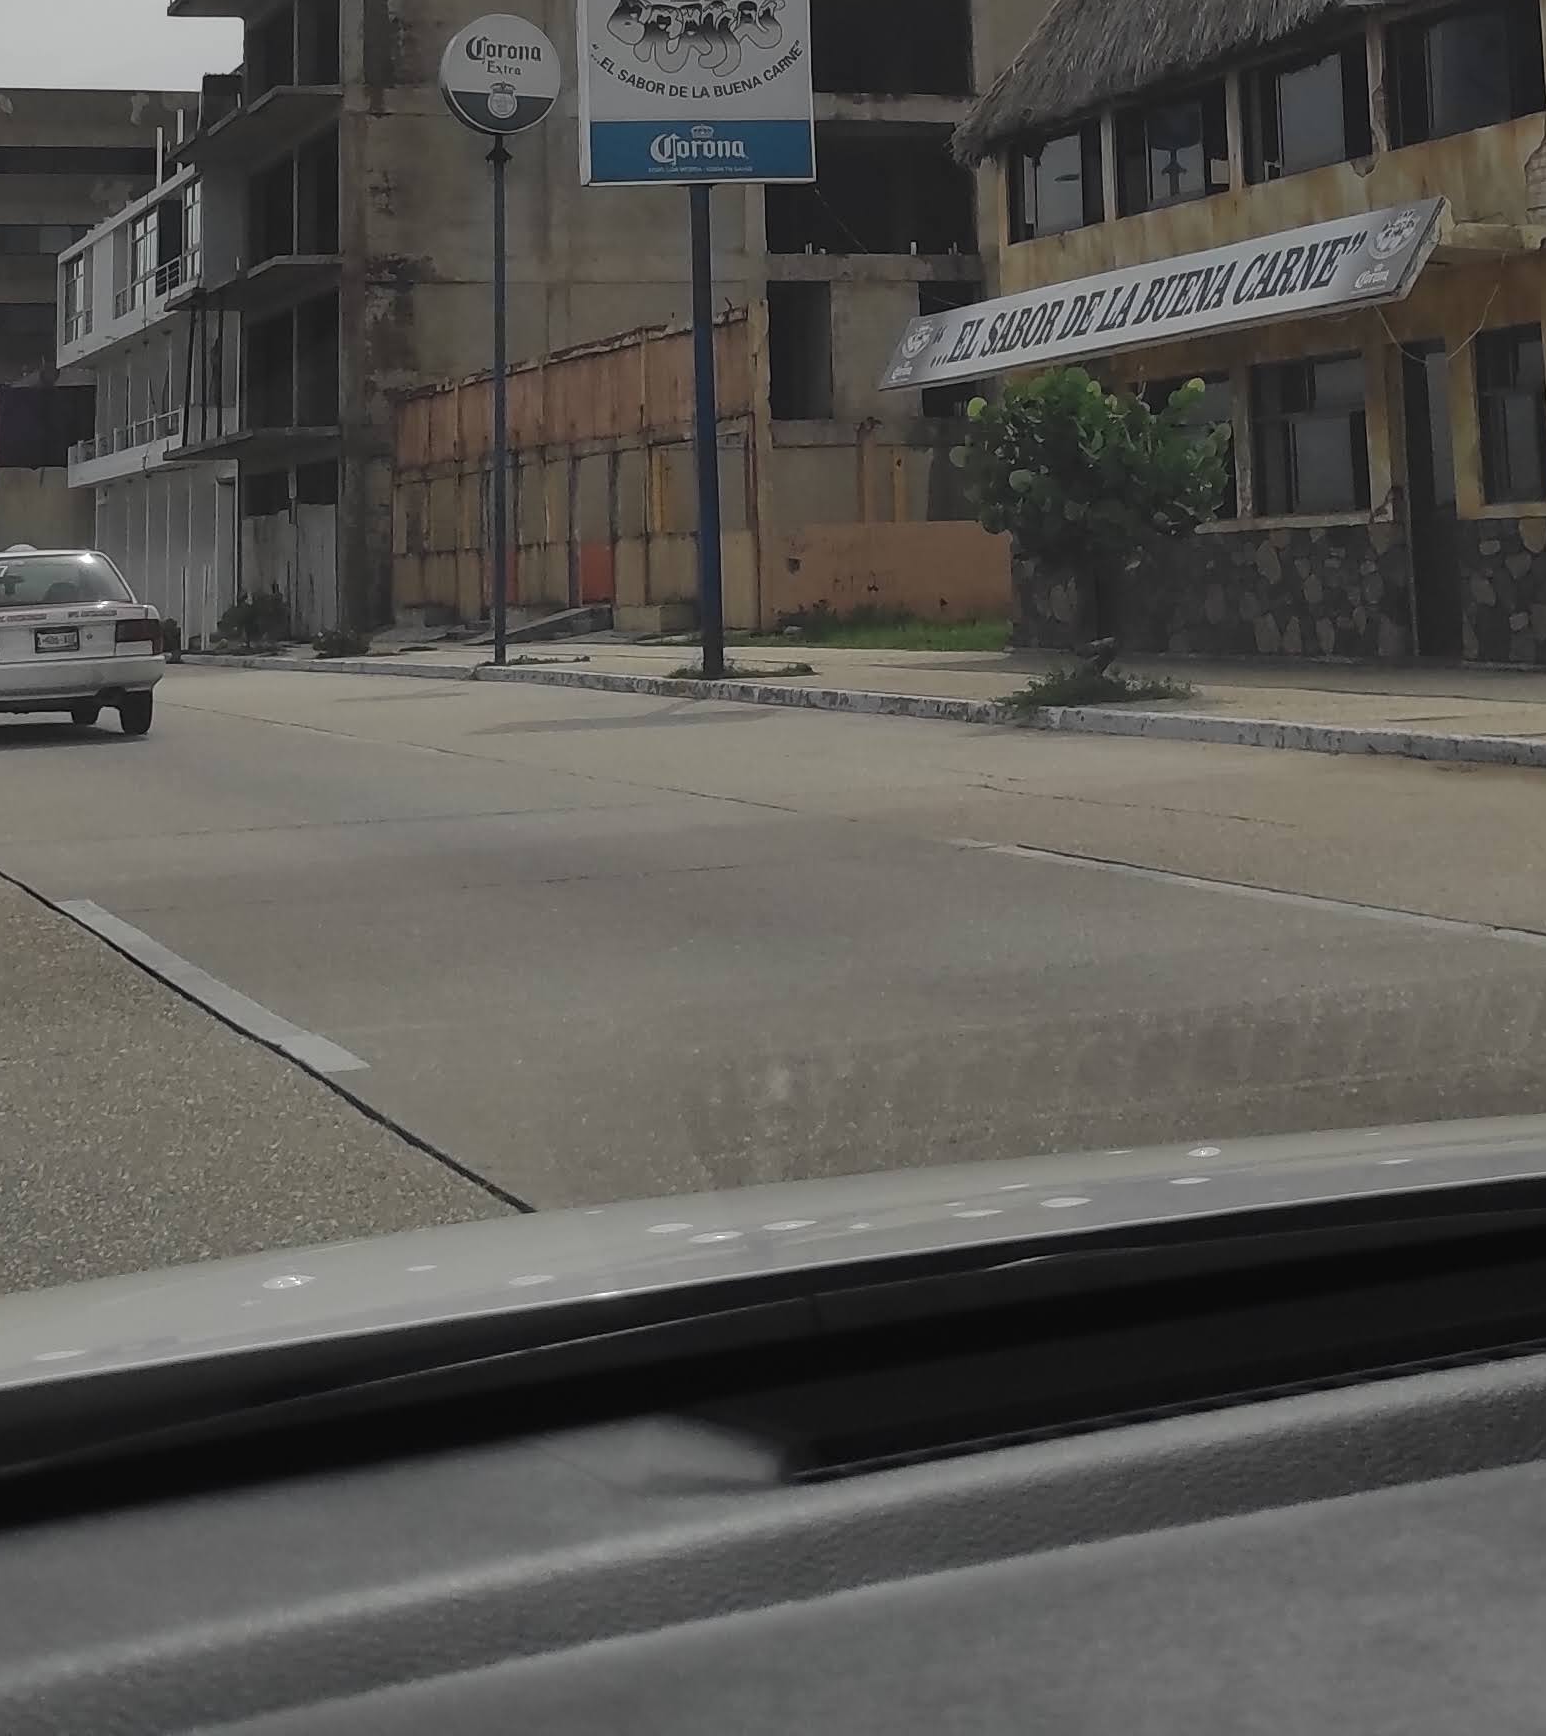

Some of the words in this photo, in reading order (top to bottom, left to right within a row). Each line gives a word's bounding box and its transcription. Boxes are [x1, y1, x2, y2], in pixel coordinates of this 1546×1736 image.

[465, 35, 542, 63] Corona
[486, 60, 522, 76] Extra
[617, 68, 666, 96] SABOR
[668, 85, 689, 99] DE
[692, 85, 711, 99] LA
[713, 77, 764, 98] BUENA
[649, 132, 747, 166] Corona
[980, 298, 1066, 359] SABOR
[1056, 291, 1104, 341] DE
[1094, 281, 1137, 333] LA
[1130, 261, 1238, 326] BUENA
